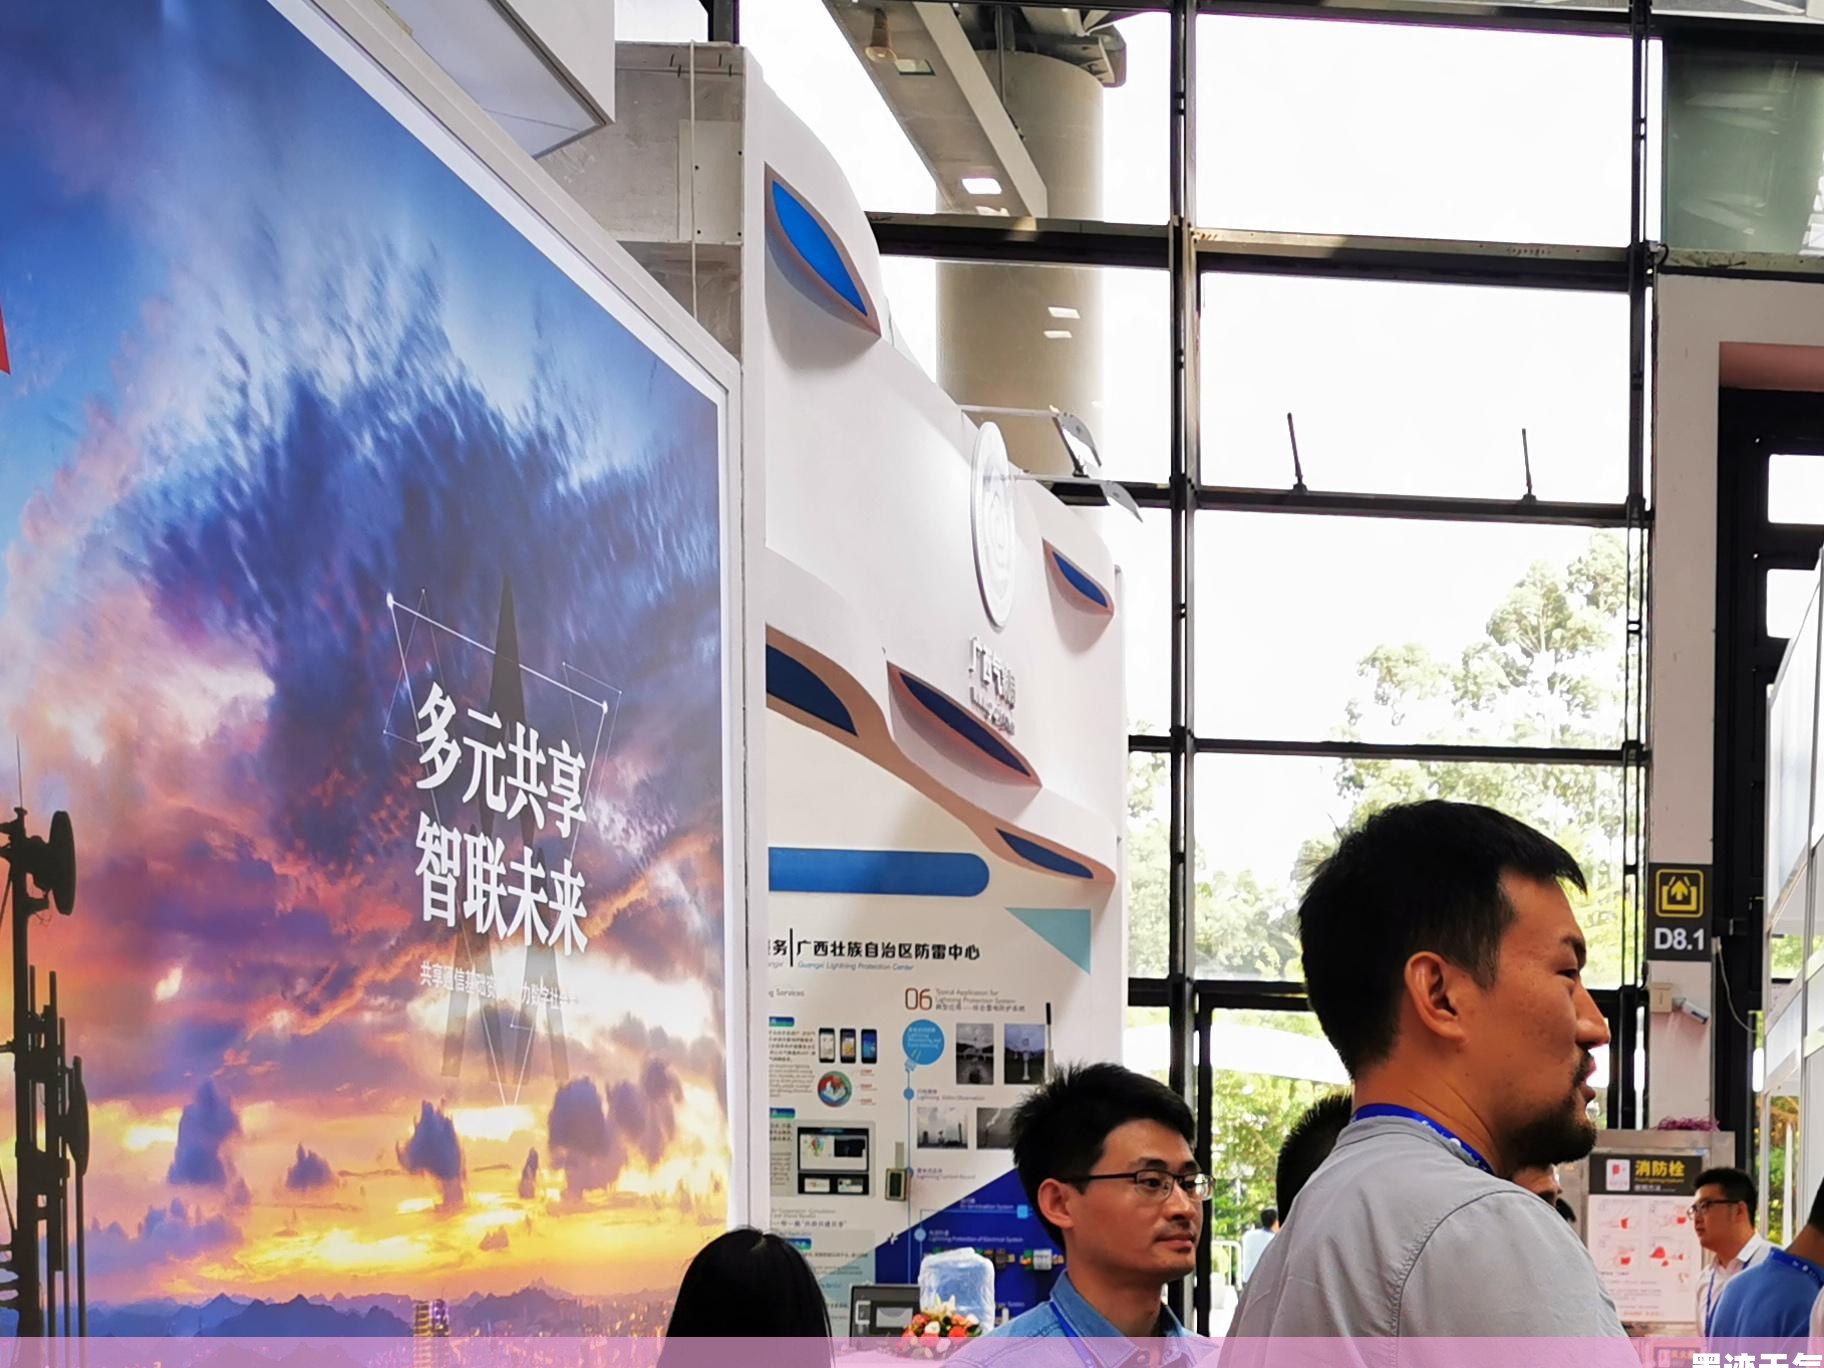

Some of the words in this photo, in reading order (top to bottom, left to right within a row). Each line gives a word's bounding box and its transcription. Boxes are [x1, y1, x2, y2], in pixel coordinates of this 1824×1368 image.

[415, 681, 588, 839] 多元共享
[414, 811, 589, 956] 智联未来
[796, 940, 981, 961] 广西壮族自治区防雷中心
[1654, 926, 1705, 952] D8.1
[905, 987, 932, 1011] 06
[1635, 1160, 1685, 1178] 消防栓
